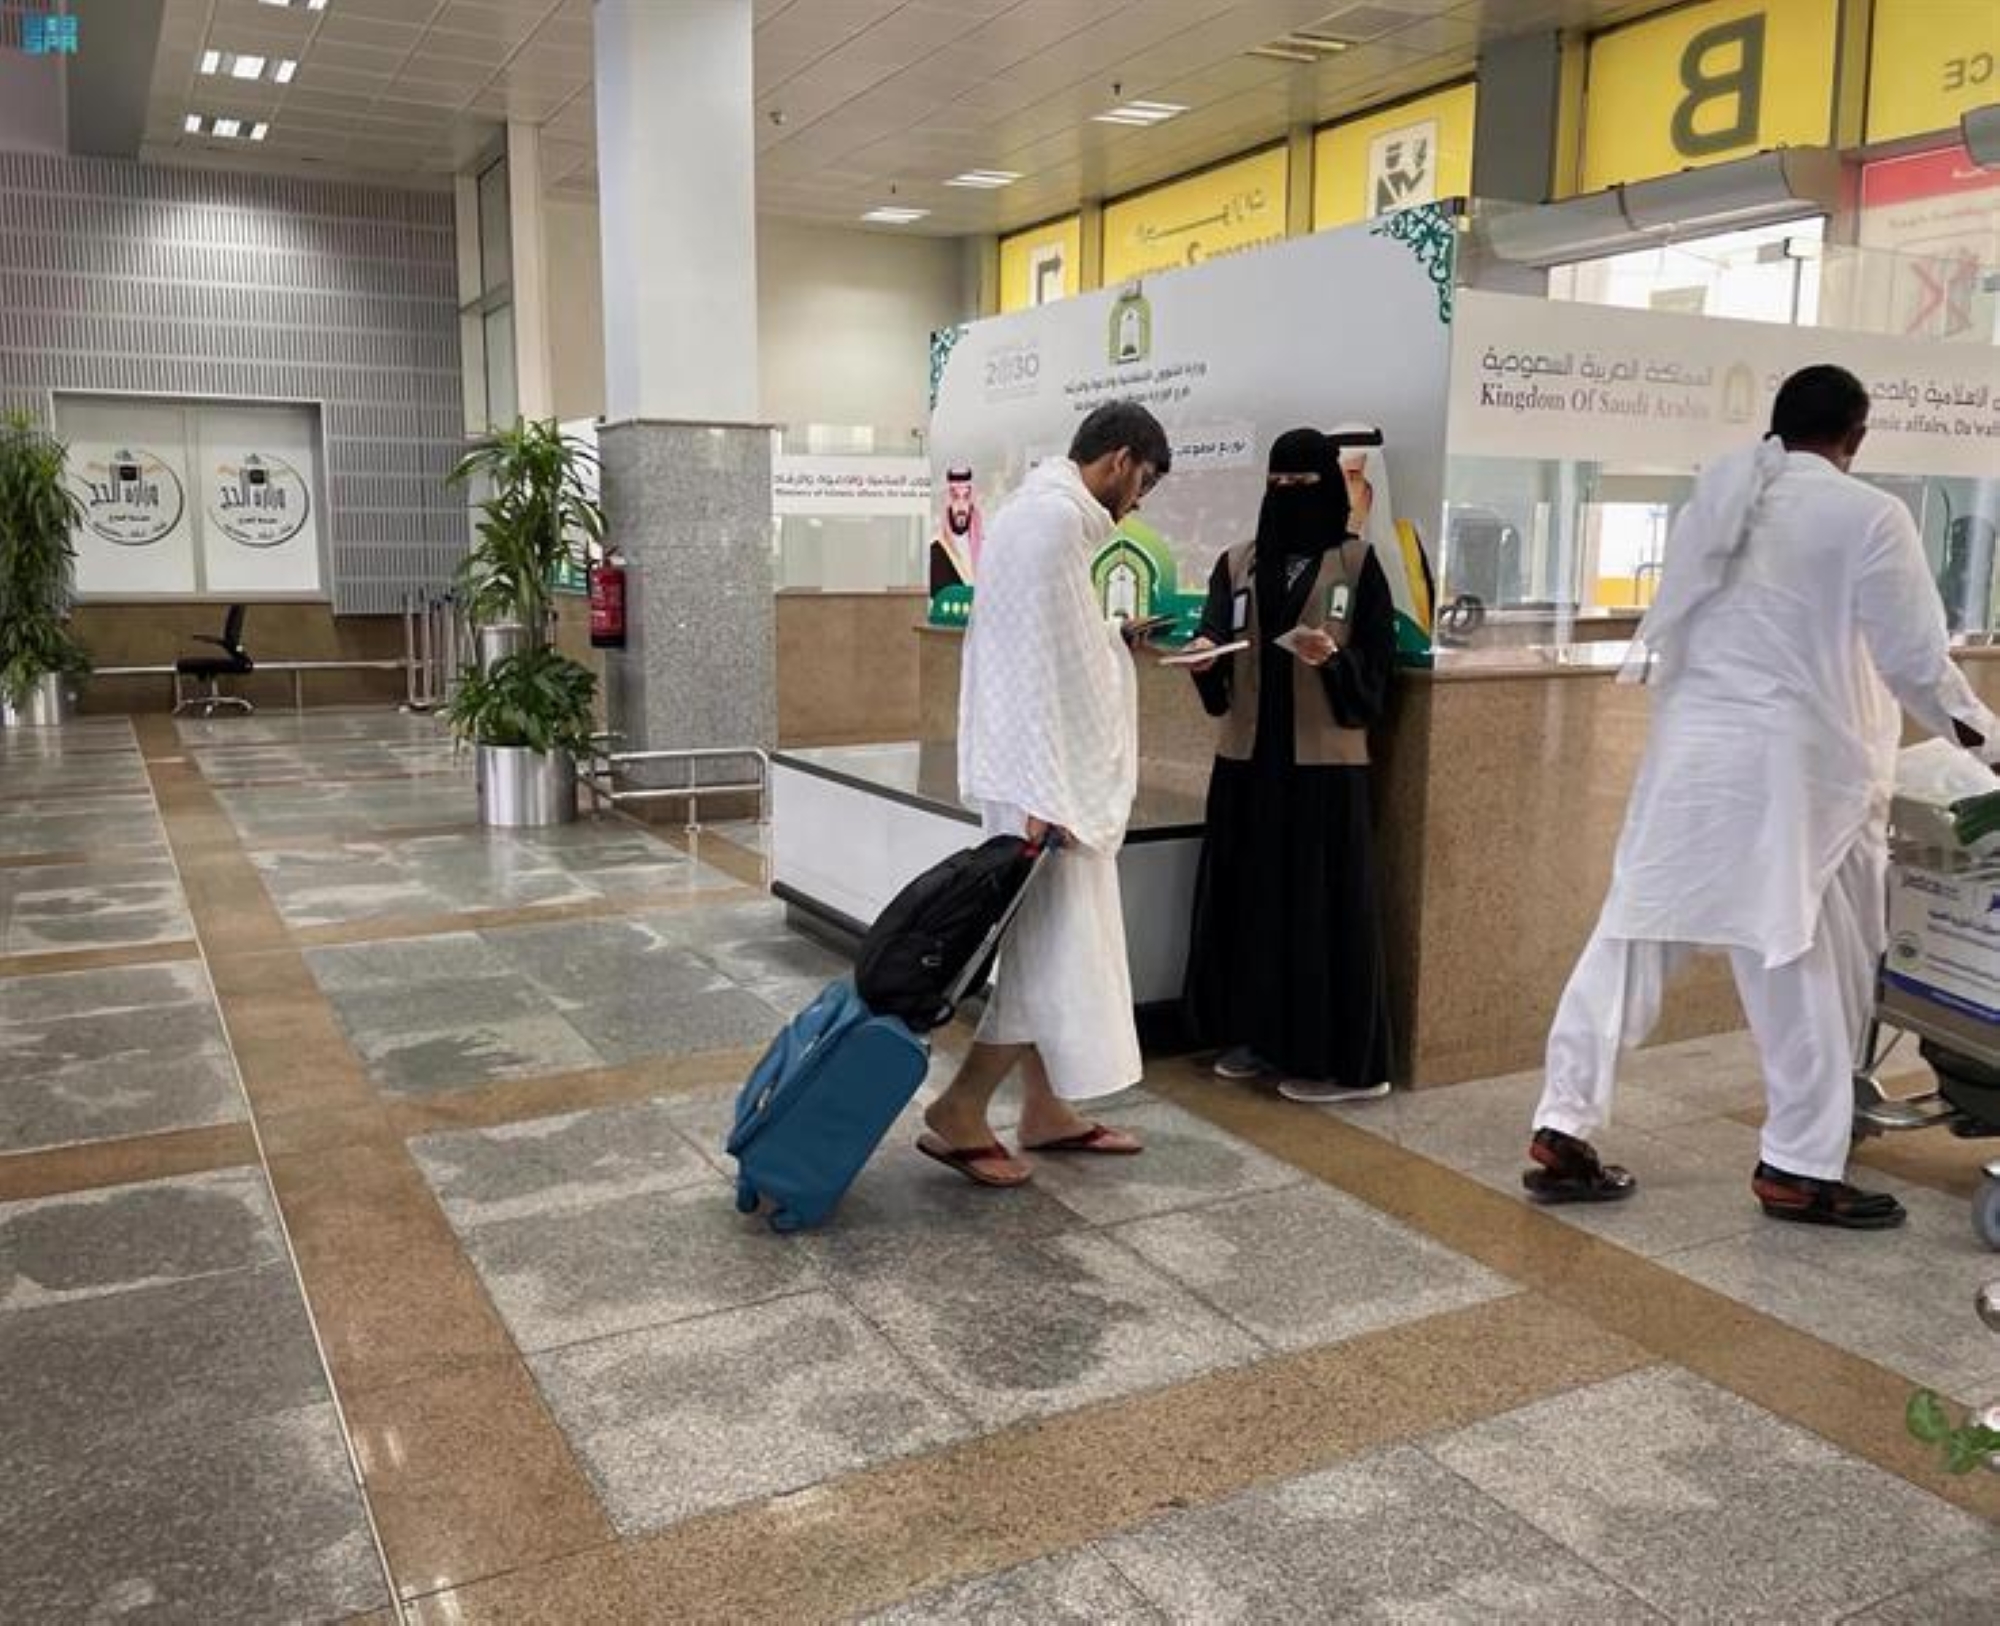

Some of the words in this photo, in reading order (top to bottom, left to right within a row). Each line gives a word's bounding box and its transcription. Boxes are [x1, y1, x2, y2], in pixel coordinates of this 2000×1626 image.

[1481, 346, 1573, 378] السعودية
[1580, 352, 1638, 384] العربية
[1480, 383, 1566, 411] Kingdom
[1572, 388, 1594, 411] Of
[1599, 390, 1649, 414] Saudi
